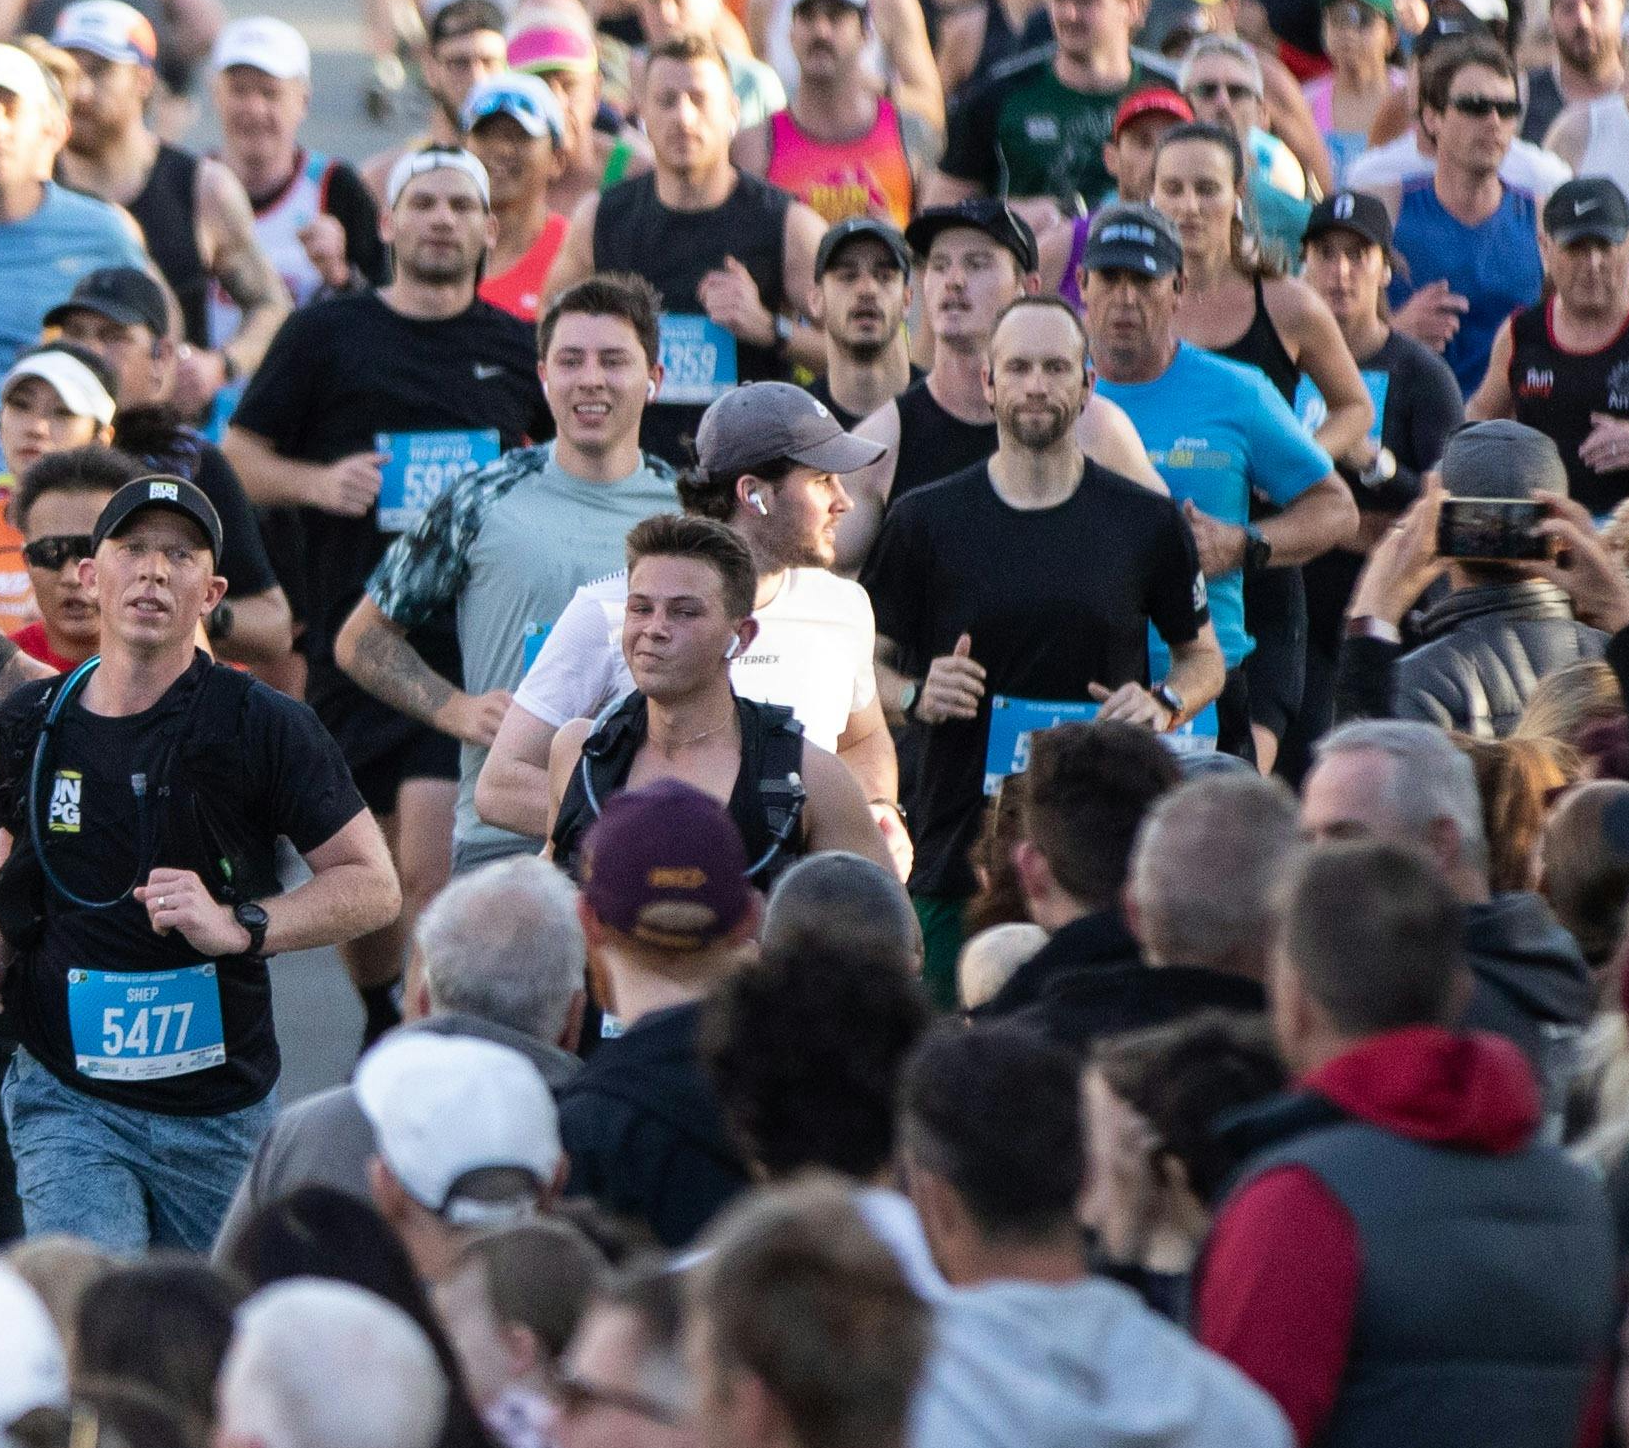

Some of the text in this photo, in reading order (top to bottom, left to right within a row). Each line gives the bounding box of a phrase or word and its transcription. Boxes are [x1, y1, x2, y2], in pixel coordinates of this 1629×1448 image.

[739, 655, 780, 665] TERREX
[126, 986, 160, 1003] SHEP
[102, 1002, 194, 1056] 5477
